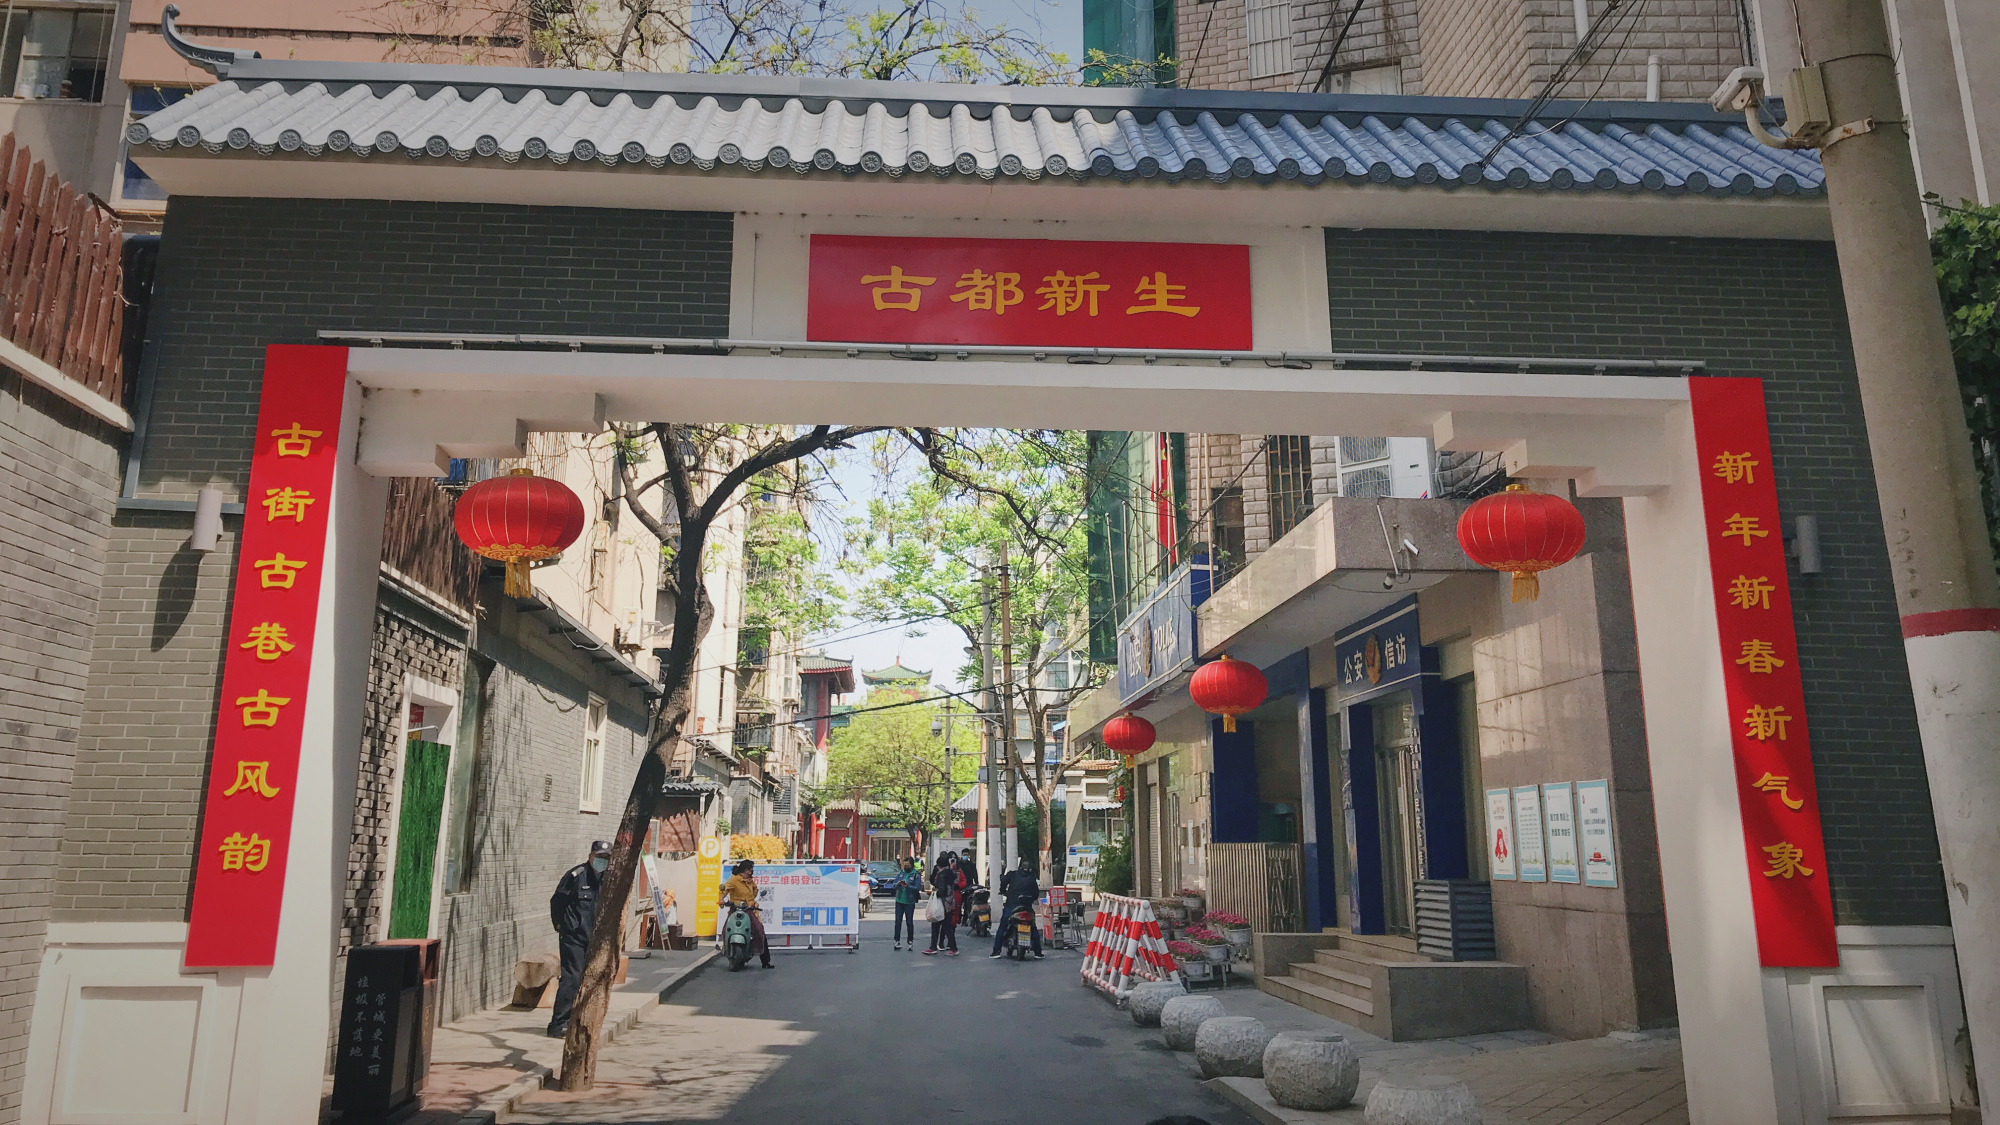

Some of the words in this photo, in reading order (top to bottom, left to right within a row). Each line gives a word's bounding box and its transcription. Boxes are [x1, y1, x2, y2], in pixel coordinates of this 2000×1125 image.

[860, 265, 1201, 318] 古都新生
[218, 422, 323, 873] 古街古巷古风韵
[1344, 649, 1363, 684] 公安
[1385, 633, 1407, 670] 信访
[1712, 450, 1814, 880] 新年新春新气象
[705, 840, 716, 855] P
[350, 976, 369, 1058] 垃圾不落地
[367, 993, 386, 1076] 管城更美丽
